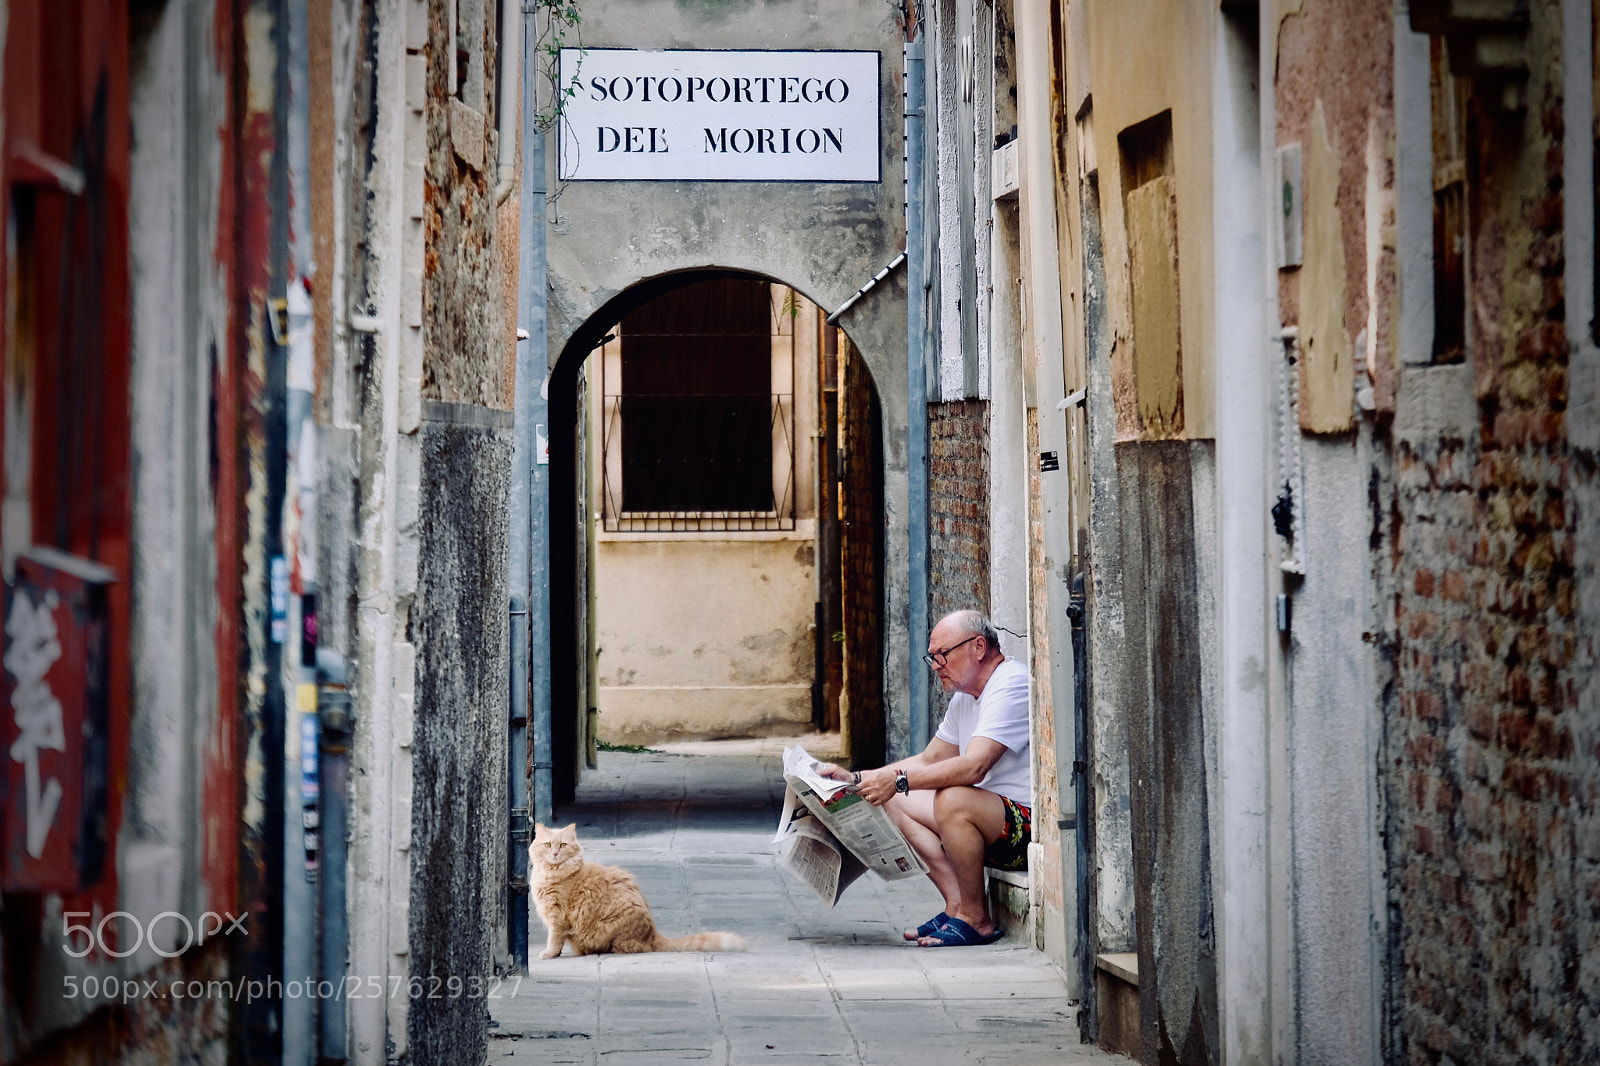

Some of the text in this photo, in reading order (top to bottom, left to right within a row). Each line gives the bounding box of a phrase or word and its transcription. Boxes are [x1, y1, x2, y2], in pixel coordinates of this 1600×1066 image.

[590, 76, 850, 103] SOTOPORTEGO
[597, 126, 843, 154] DEL MORION
